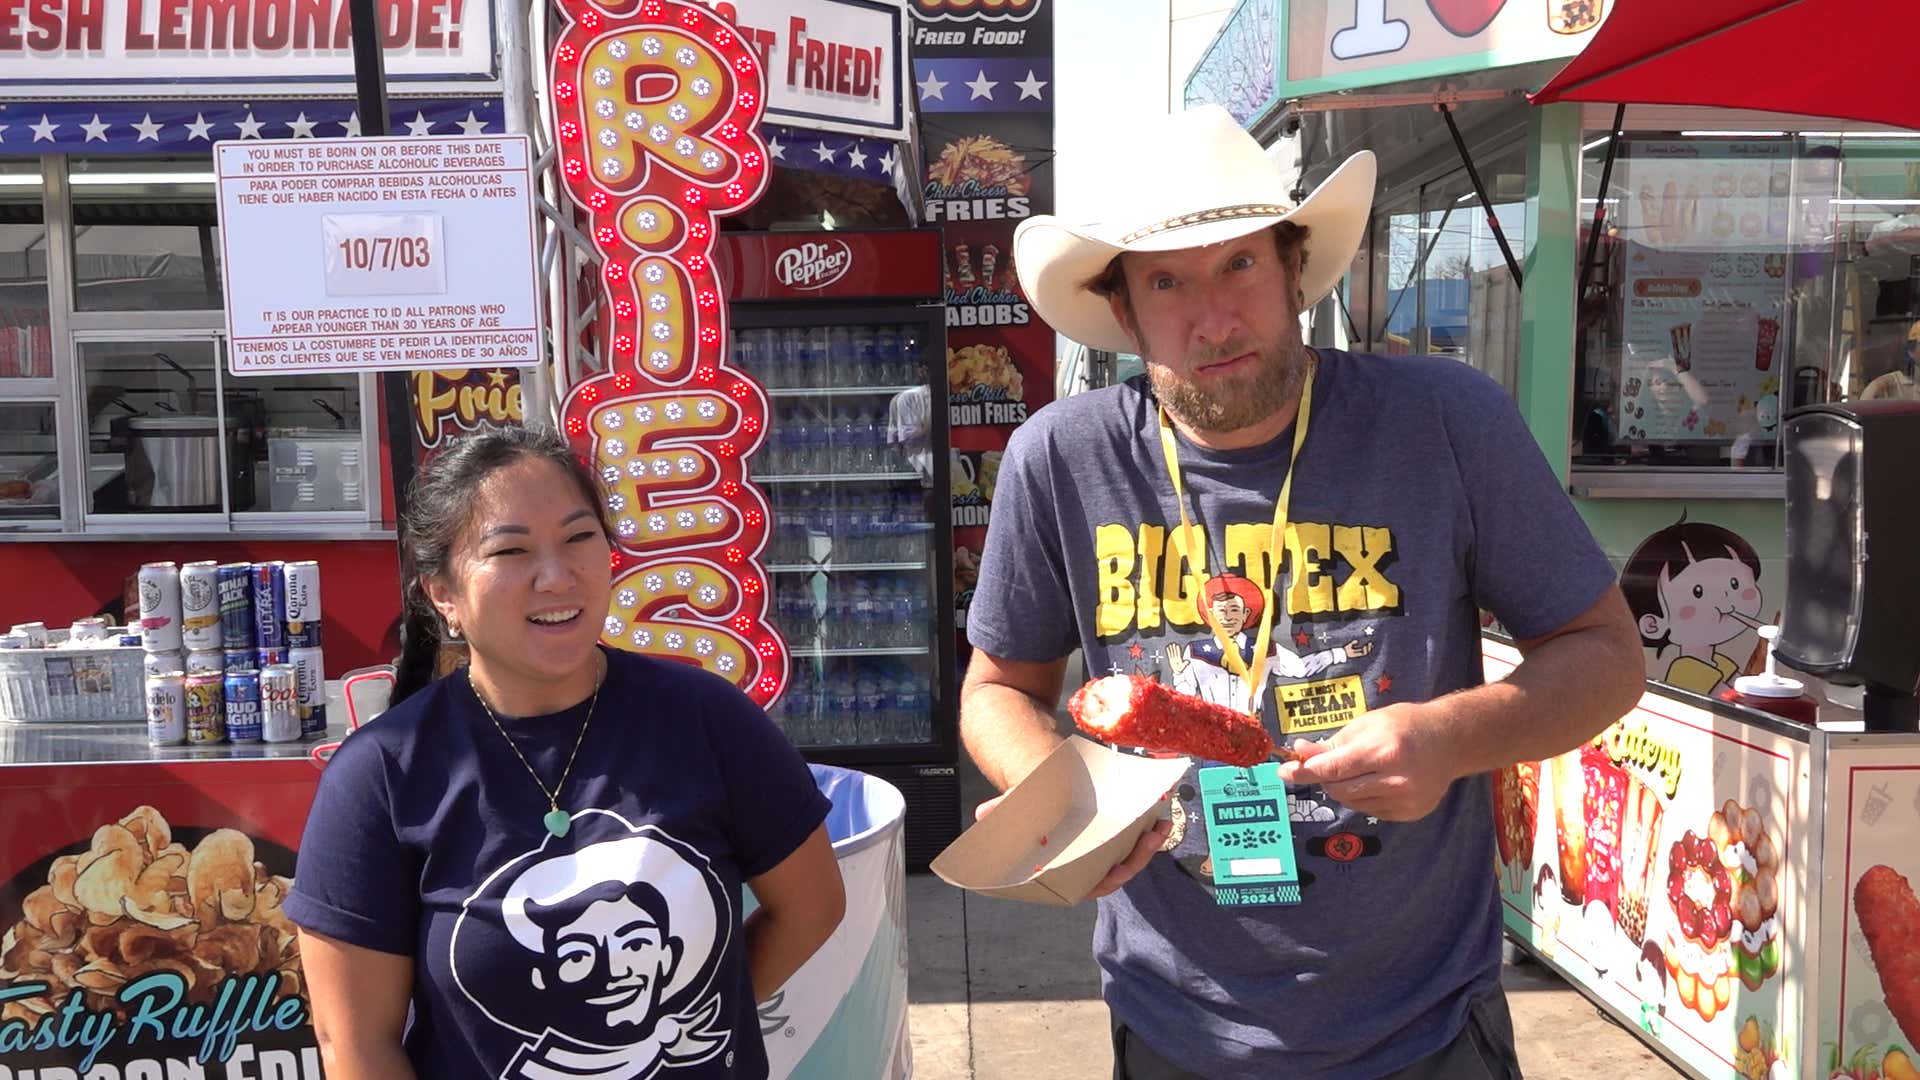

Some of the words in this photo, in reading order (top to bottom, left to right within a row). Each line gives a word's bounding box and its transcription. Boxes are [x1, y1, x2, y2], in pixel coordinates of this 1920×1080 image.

[915, 28, 966, 45] FRIED
[972, 27, 1026, 45] FOOD!
[787, 16, 883, 99] FRIED!
[248, 149, 270, 160] YOU
[274, 148, 303, 159] MUST
[308, 148, 322, 158] BE
[327, 147, 357, 158] BORN
[361, 146, 377, 157] ON
[381, 146, 396, 156] OR
[401, 145, 442, 155] BEFORE
[447, 144, 471, 154] THIS
[475, 143, 502, 154] DATE
[243, 163, 254, 173] IN
[258, 162, 295, 172] ORDER
[300, 161, 313, 171] TO
[317, 160, 374, 171] PURCHASE
[378, 158, 439, 169] ALCOHOLIC
[443, 156, 505, 167] BEVERAGES
[250, 181, 277, 191] PARA
[281, 180, 317, 190] PODER
[322, 178, 375, 189] COMPRAR
[379, 176, 424, 187] BEBIDAS
[428, 175, 502, 186] ALCOHOLICAS
[238, 194, 268, 205] TIENE
[272, 193, 294, 203] QUE
[298, 192, 334, 202] HABER
[338, 191, 378, 201] NACIDO
[383, 190, 397, 200] EN
[401, 189, 427, 200] ESTA
[431, 188, 466, 199] FECHA
[470, 188, 478, 198] O
[482, 187, 517, 198] ANTES
[925, 197, 1030, 222] FRIES
[340, 237, 430, 271] 10/7/03
[801, 242, 828, 265] Dr
[776, 248, 846, 286] Pepper
[263, 311, 273, 321] IT
[277, 311, 287, 321] IS
[291, 310, 314, 320] OUR
[318, 308, 369, 320] PRACTICE
[374, 308, 387, 318] TO
[391, 307, 402, 317] ID
[406, 307, 425, 317] ALL
[429, 305, 476, 316] PATRONS
[480, 304, 506, 314] WHO
[271, 324, 312, 334] APPEAR
[316, 322, 367, 333] YOUNGER
[371, 320, 399, 331] THAN
[403, 320, 417, 330] 30
[421, 318, 456, 329] YEARS
[461, 318, 475, 327] OF
[479, 317, 500, 327] AGE
[237, 342, 288, 353] TENEMOS
[293, 341, 306, 351] LA
[310, 339, 376, 350] COSTUMBRE
[380, 338, 394, 348] DE
[399, 336, 431, 347] PEDIR
[434, 336, 447, 346] LA
[452, 334, 533, 346] IDENTIFICACION
[243, 356, 251, 365] A
[255, 355, 276, 365] LOS
[281, 353, 331, 364] CLIENTES
[336, 352, 357, 362] QUE
[363, 351, 376, 361] SE
[380, 350, 403, 361] VEN
[405, 348, 457, 360] MENORES
[461, 348, 476, 358] DE
[480, 347, 495, 357] 30
[499, 345, 528, 356] AÑOS
[414, 370, 523, 438] Frie
[985, 401, 1027, 423] FRIES
[1095, 523, 1206, 638] BIG
[1225, 522, 1400, 616] TEX
[289, 574, 299, 620] Corona
[1300, 687, 1315, 697] THE
[1316, 683, 1337, 696] MOST
[226, 701, 257, 715] BUD
[1284, 691, 1357, 717] TEXAN
[1293, 715, 1317, 728] PLACE
[1318, 715, 1330, 725] ON
[1330, 711, 1354, 723] EARTH
[1218, 804, 1275, 820] MEDIA
[1241, 894, 1276, 905] 2024
[120, 973, 306, 1064] Ruffle
